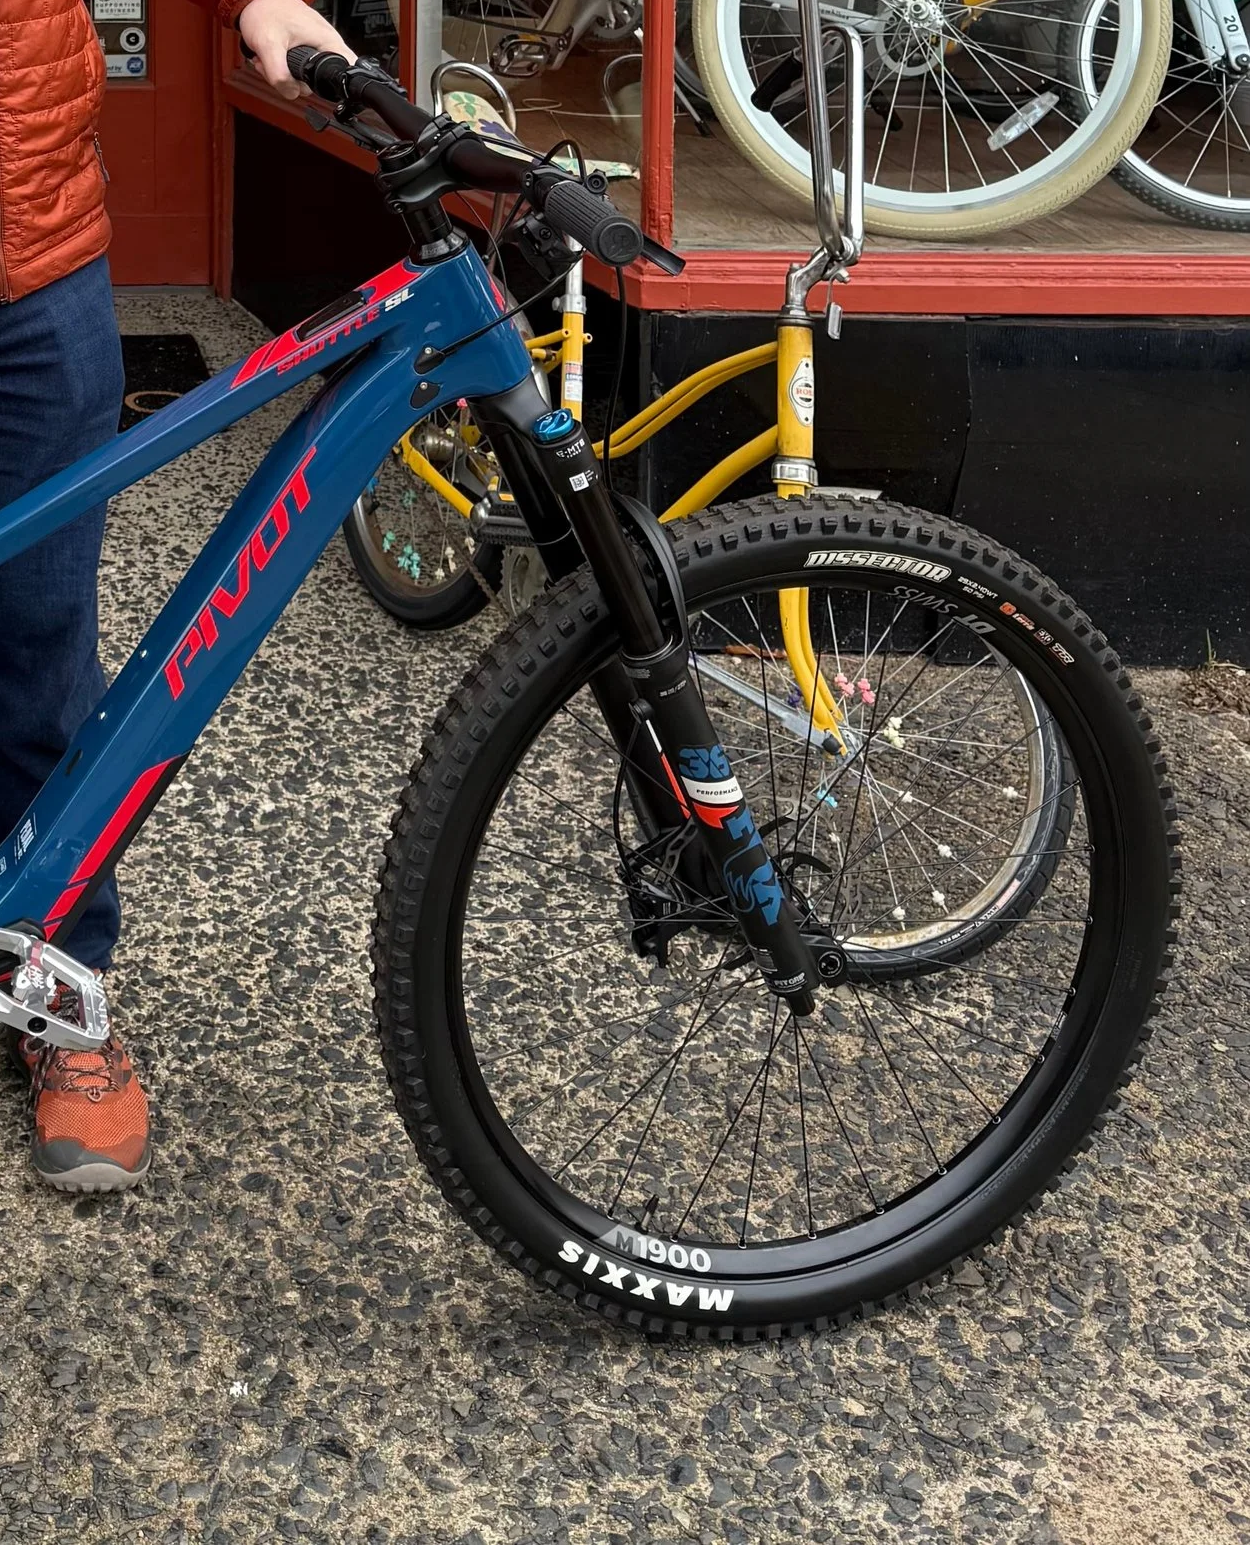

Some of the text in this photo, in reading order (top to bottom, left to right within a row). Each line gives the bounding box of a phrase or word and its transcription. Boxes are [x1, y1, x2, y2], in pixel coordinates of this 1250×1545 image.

[1223, 14, 1237, 34] 20
[384, 287, 416, 313] SL
[162, 446, 317, 701] PIVOT
[803, 549, 953, 583] DISSECTOR
[887, 584, 998, 635] DT SWISS
[678, 744, 731, 779] 36
[696, 786, 739, 797] PERFORMANCE
[558, 1239, 735, 1312] MAXXIS
